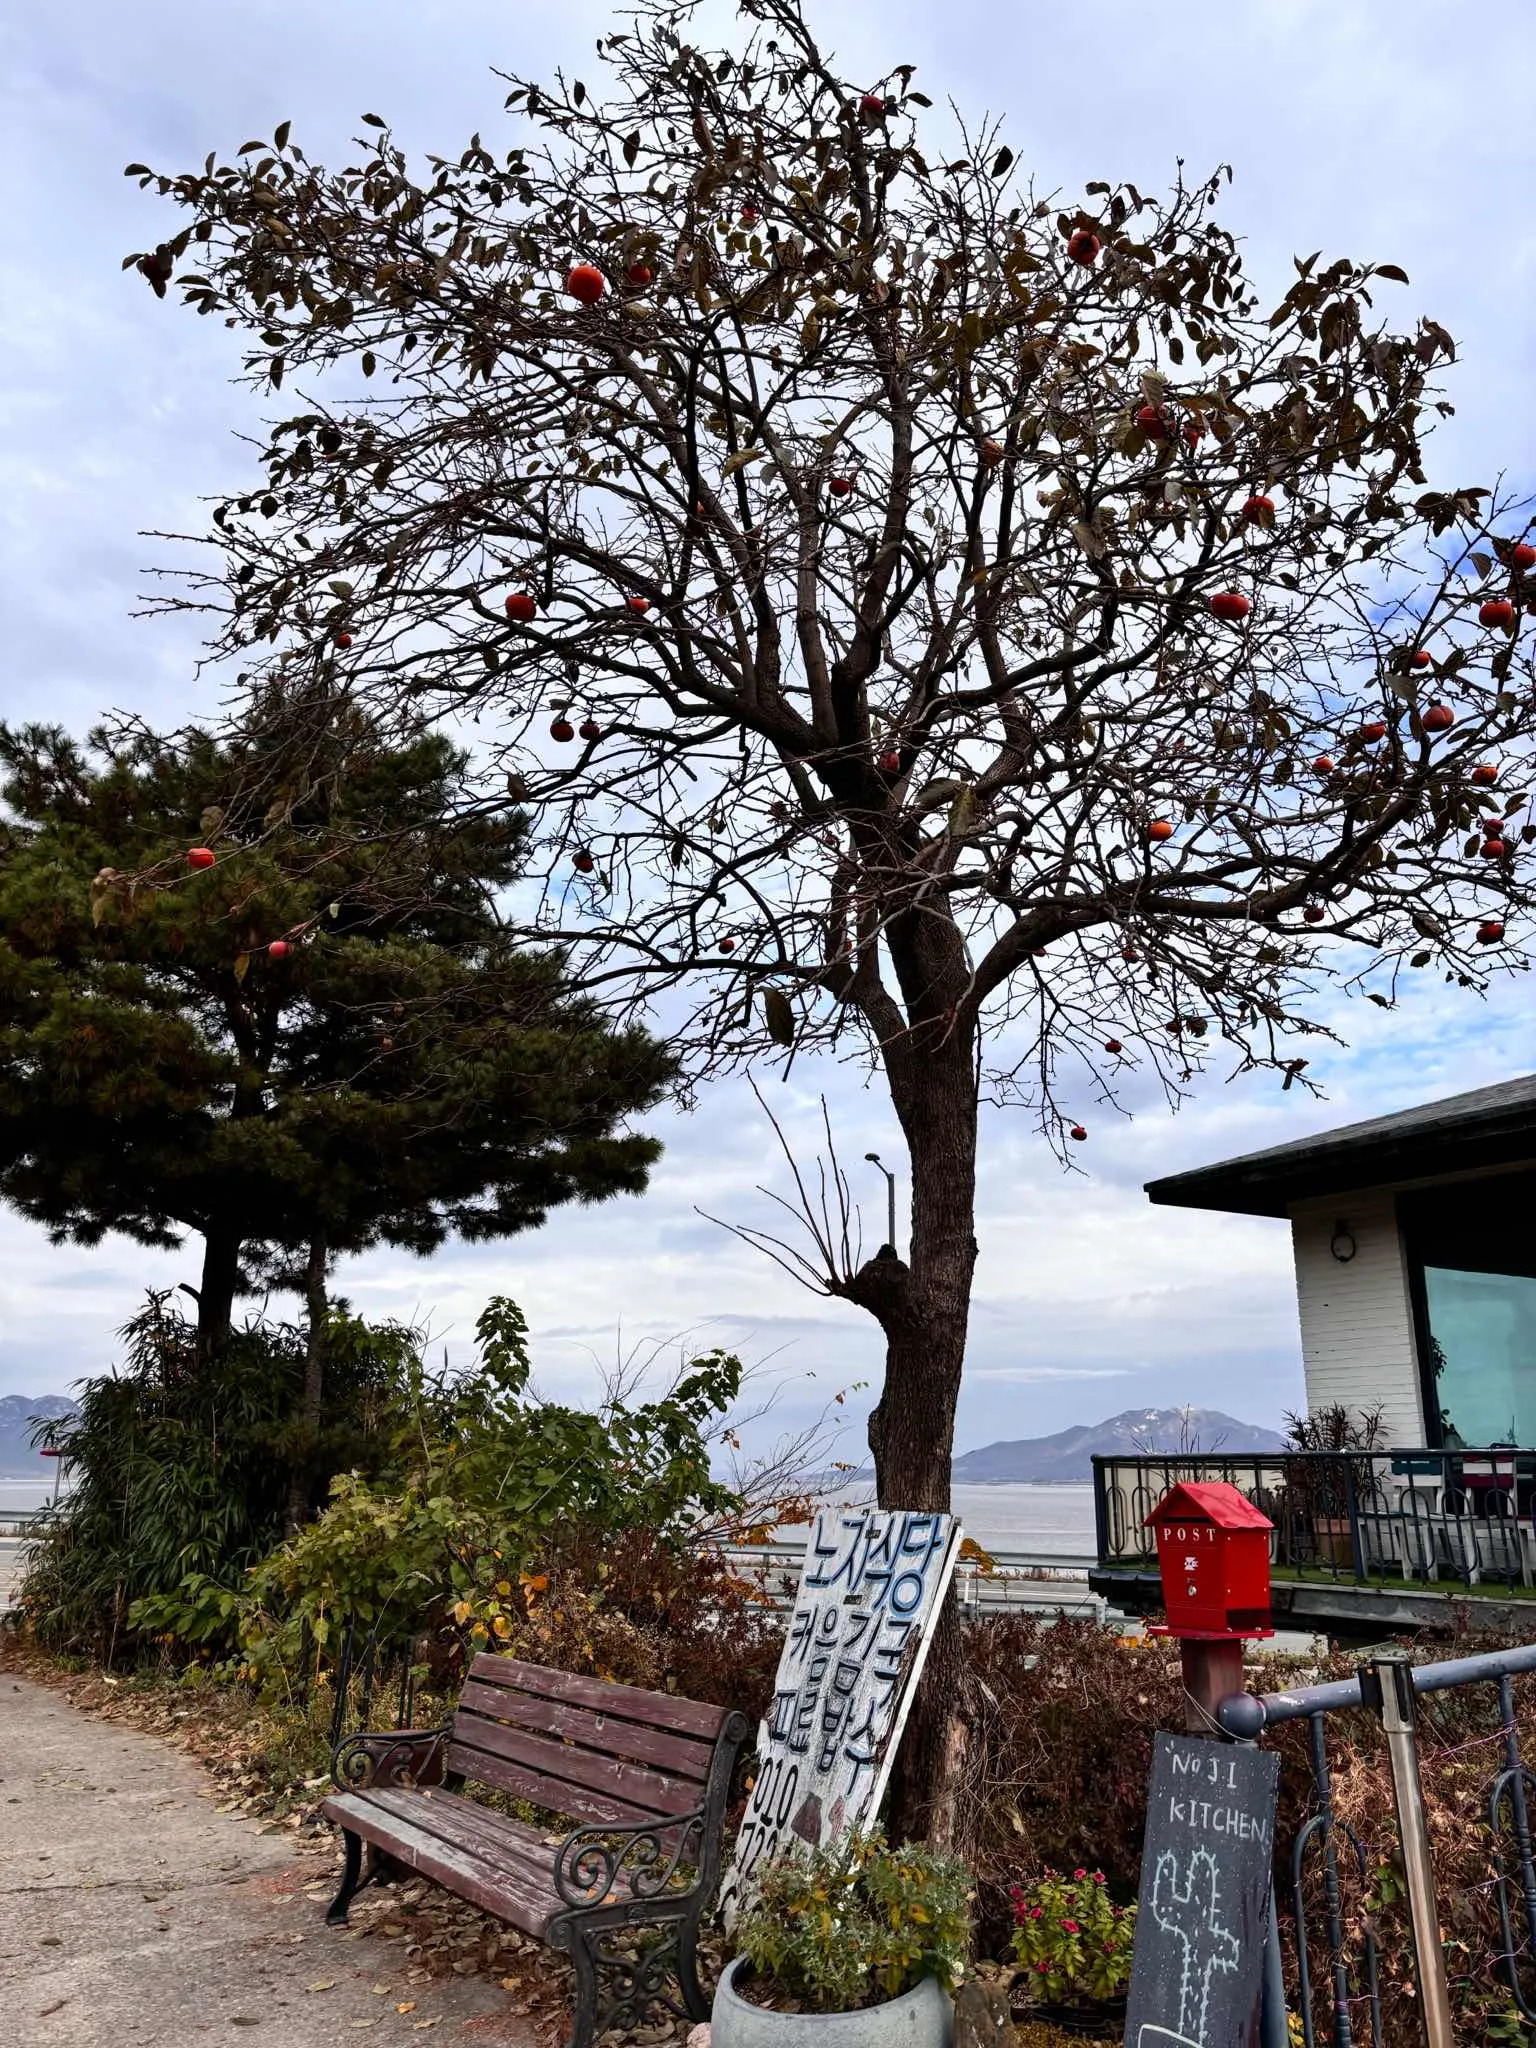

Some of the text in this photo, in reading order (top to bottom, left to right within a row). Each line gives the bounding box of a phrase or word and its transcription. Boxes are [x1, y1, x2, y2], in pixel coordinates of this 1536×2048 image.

[805, 1514, 943, 1615] 노지식당
[1163, 1527, 1216, 1542] POST
[753, 1756, 799, 1830] 010
[1170, 1796, 1266, 1842] KITCHEN
